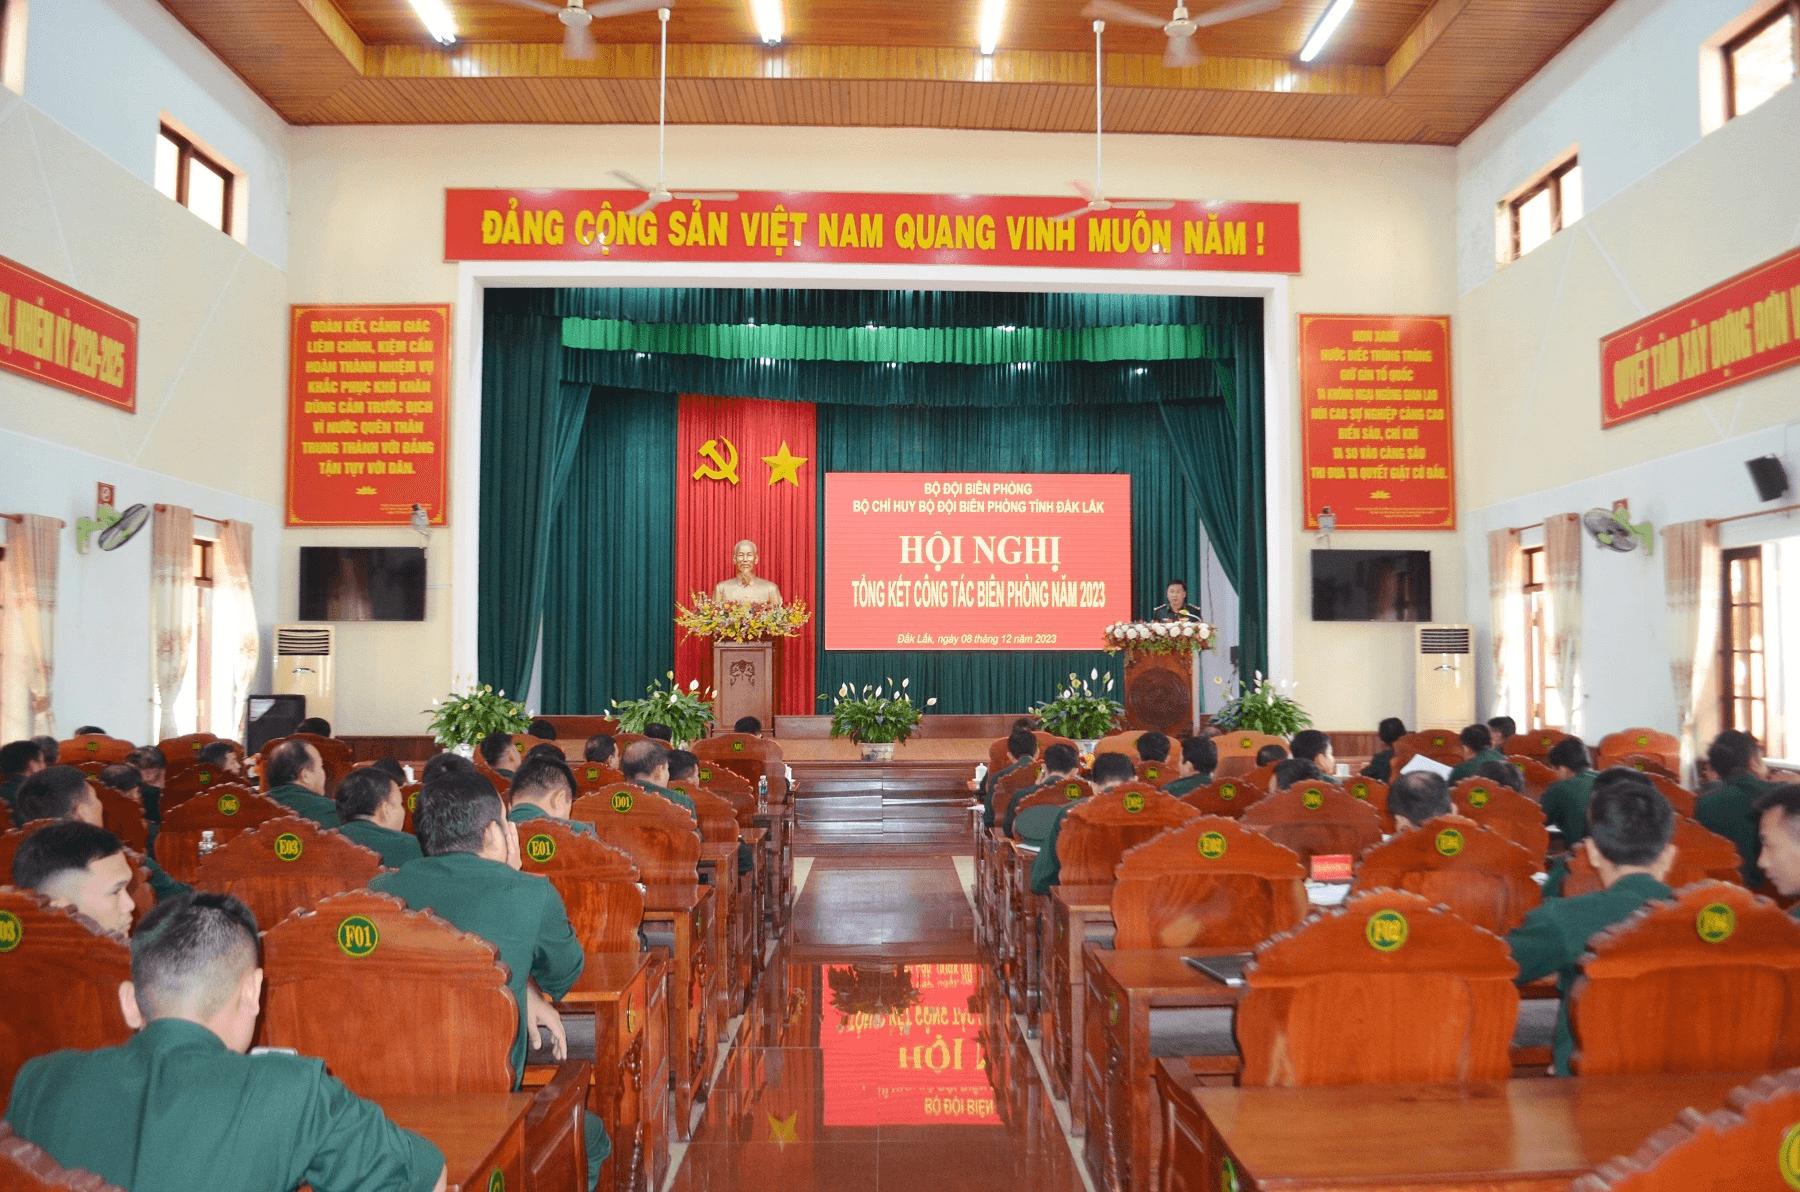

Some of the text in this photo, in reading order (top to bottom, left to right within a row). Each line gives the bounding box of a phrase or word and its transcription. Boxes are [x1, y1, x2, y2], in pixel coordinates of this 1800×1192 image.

[482, 198, 564, 245] ĐẢNG
[575, 200, 658, 255] CỘNG
[668, 199, 728, 246] SẢN
[741, 204, 808, 256] VIỆT
[819, 213, 883, 248] NAM
[895, 213, 996, 251] QUANG
[1006, 216, 1076, 251] VINH
[1089, 210, 1172, 254] MUÔN
[1184, 213, 1247, 255] NĂM
[923, 480, 1033, 498] BỘ ĐỘI BIÊN PHÒNG
[852, 498, 870, 516] BỘ
[871, 497, 891, 513] CHỈ
[893, 500, 916, 514] HUY
[918, 498, 936, 516] BỘ
[937, 498, 957, 516] ĐỘI
[958, 498, 986, 514] BIÊN
[987, 498, 1027, 514] PHÒNG
[1028, 498, 1055, 514] TỈNH
[898, 530, 1062, 573] HỘI NGHỊ
[851, 573, 1107, 609] TỔNG KẾT CÔNG TÁC BIÊN PHÒNG NĂM 2023
[897, 632, 915, 644] Đắk
[937, 634, 959, 647] ngày
[961, 634, 973, 644] 08
[973, 633, 1000, 647] tháng
[1002, 634, 1013, 644] 12
[1014, 633, 1033, 644] năm
[1035, 634, 1058, 644] 2023
[615, 796, 629, 808] D01
[280, 839, 297, 854] E03
[531, 841, 550, 856] E01
[0, 919, 16, 942] 03
[344, 924, 371, 948] F01
